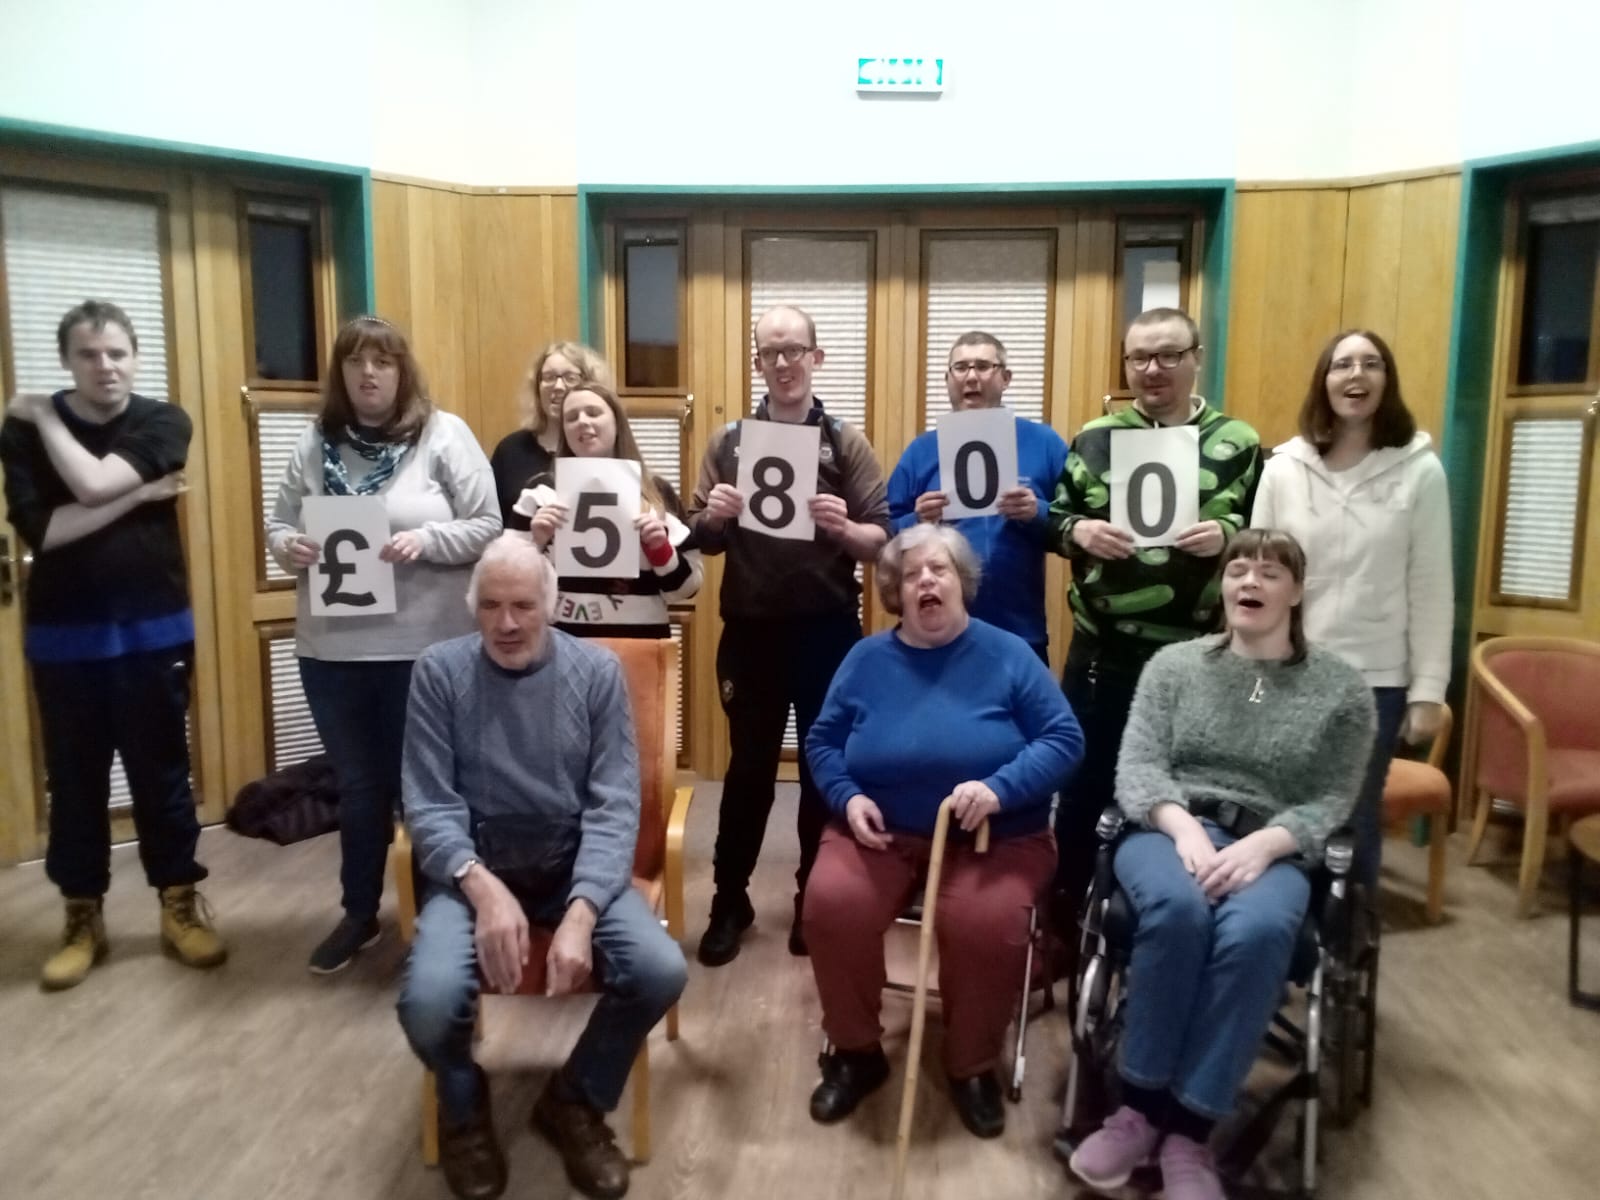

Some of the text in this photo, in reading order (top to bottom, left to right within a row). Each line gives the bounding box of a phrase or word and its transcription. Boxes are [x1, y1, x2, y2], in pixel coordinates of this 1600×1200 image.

[749, 457, 795, 529] 8
[954, 441, 999, 510] 0
[1127, 463, 1175, 537] 0
[571, 492, 620, 568] 5
[319, 529, 377, 608] £
